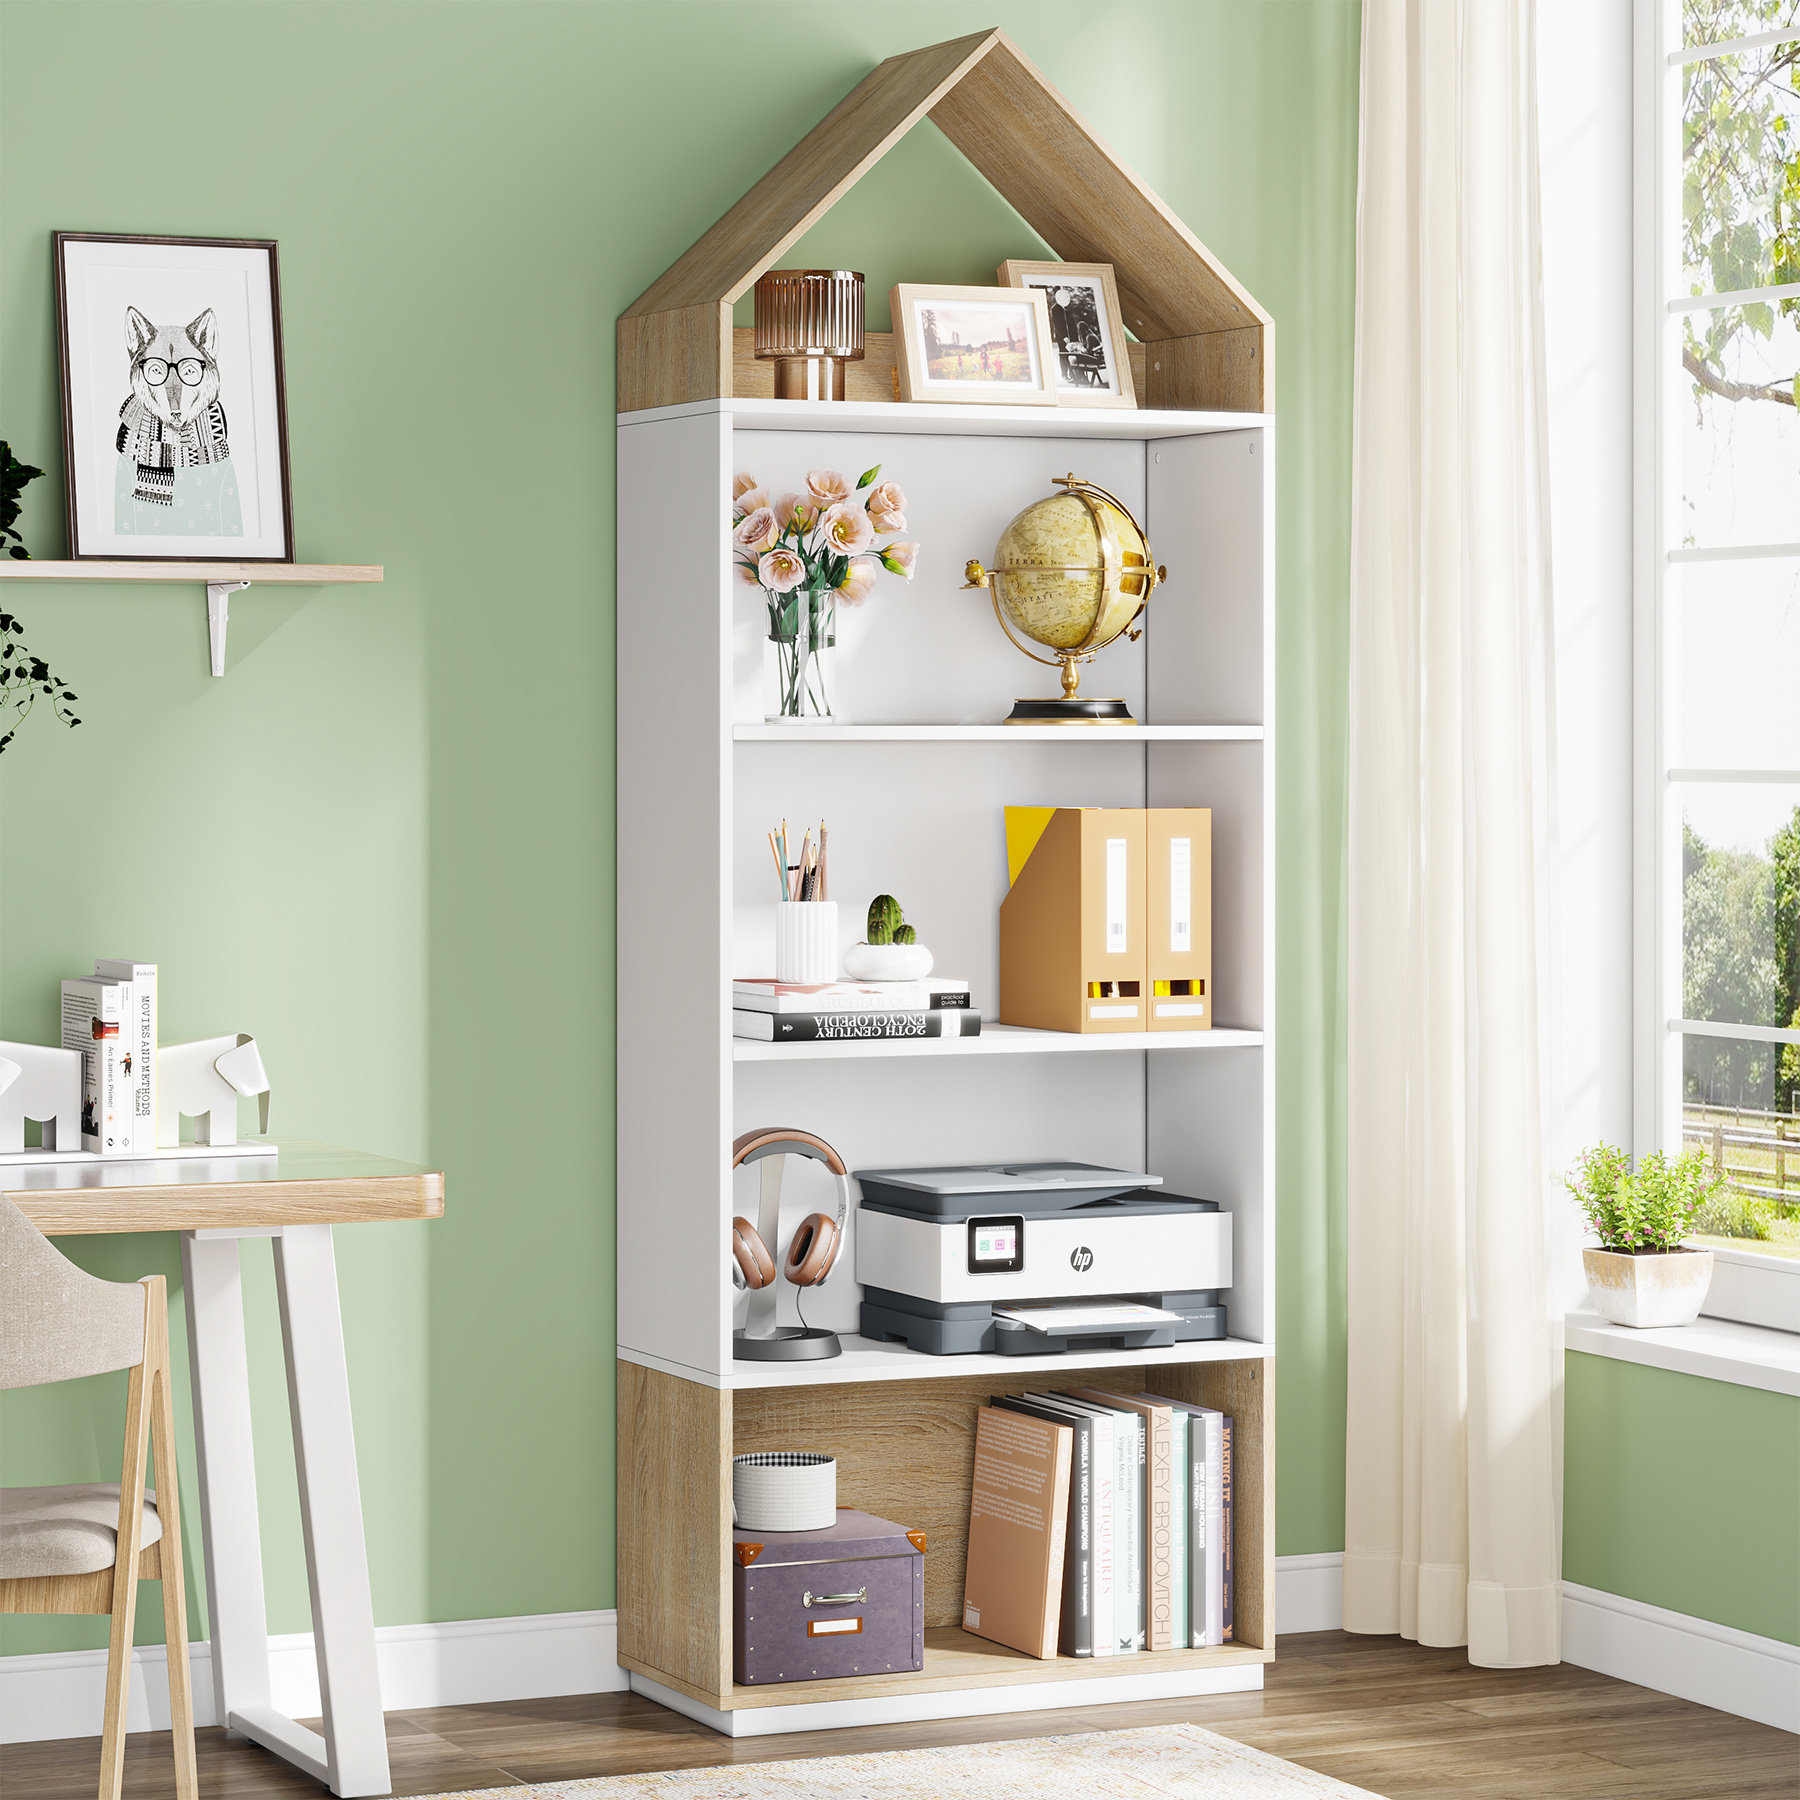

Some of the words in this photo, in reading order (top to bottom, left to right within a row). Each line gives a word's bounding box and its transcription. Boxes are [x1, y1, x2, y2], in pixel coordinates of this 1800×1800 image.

[141, 996, 149, 1039] MOVIES
[814, 1014, 926, 1027] ENCYCLOPEDIA
[814, 1026, 882, 1038] CENTURY
[885, 1024, 927, 1036] 20TH
[107, 1046, 114, 1057] An
[141, 1041, 150, 1064] AND
[141, 1065, 150, 1117] METHODS
[1071, 1246, 1093, 1272] hp
[1080, 1430, 1089, 1468] FORMULA
[1118, 1436, 1126, 1462] Virginia
[1155, 1414, 1170, 1494] ALEXEY
[1222, 1428, 1231, 1484] MAKING
[1080, 1475, 1089, 1504] WORLD
[1118, 1463, 1126, 1491] McLeod
[1125, 1464, 1134, 1512] Contemporary
[1222, 1487, 1231, 1502] IT
[1080, 1505, 1089, 1551] CHAMPIONS
[1101, 1479, 1112, 1595] ANTIQUAIRES
[1154, 1500, 1170, 1635] BRODOVITCH
